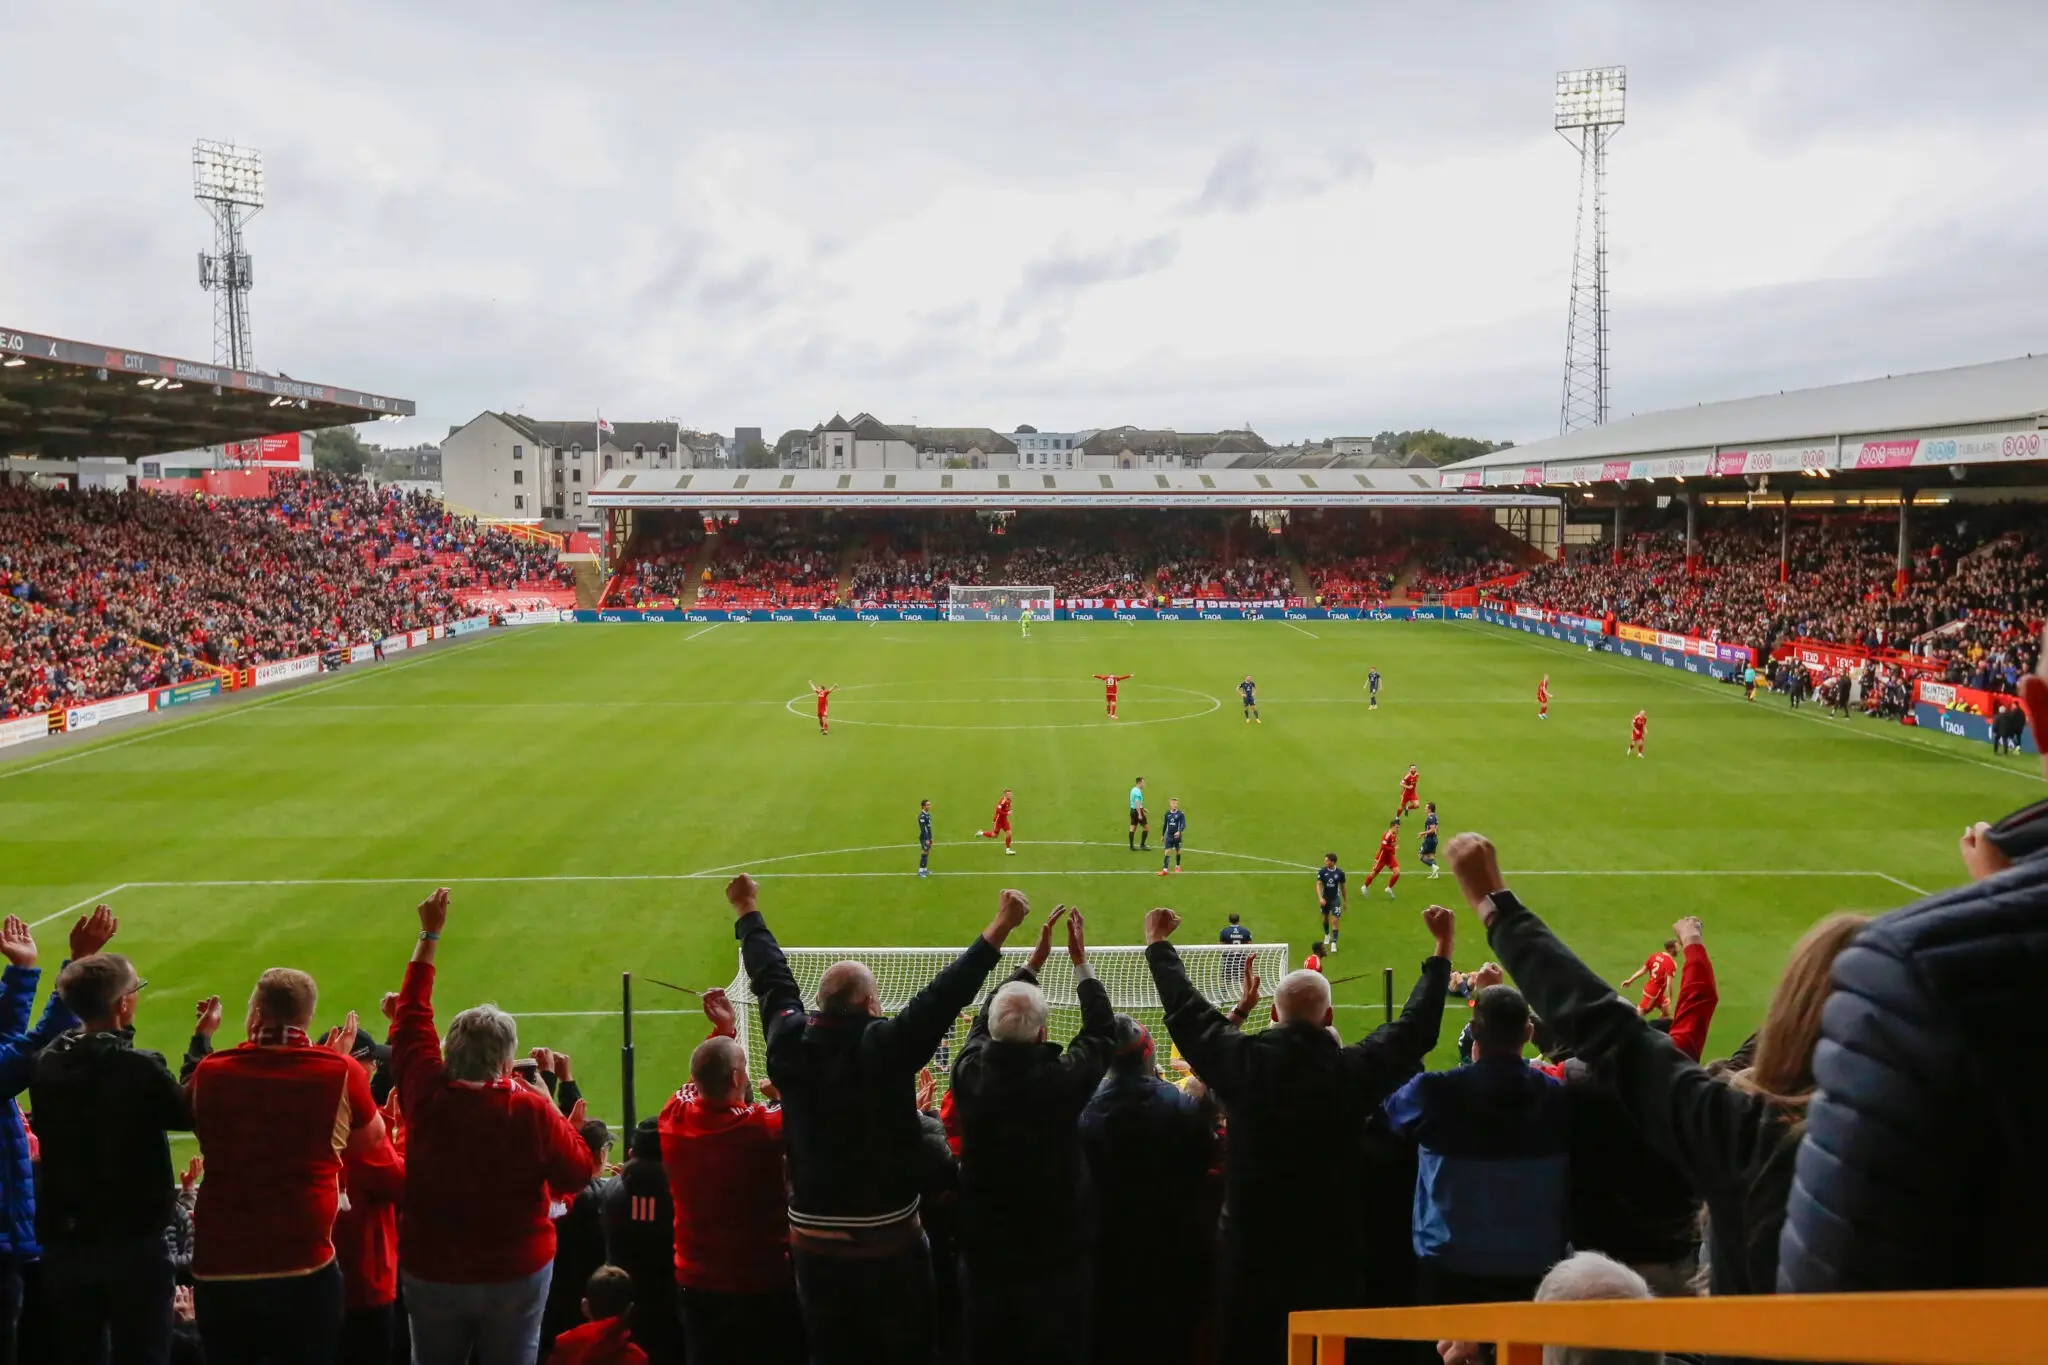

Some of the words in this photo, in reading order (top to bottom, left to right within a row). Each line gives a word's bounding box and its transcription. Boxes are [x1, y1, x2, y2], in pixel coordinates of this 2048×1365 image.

[124, 354, 144, 369] CITY
[176, 362, 220, 382] COMMUNITY
[1925, 440, 1956, 461] RAM
[1959, 441, 1997, 454] TUBULARS
[2002, 434, 2040, 456] RAM
[1802, 651, 1818, 663] TEXO
[1712, 668, 1723, 679] TAQA
[1945, 721, 1964, 736] TAQA
[1652, 962, 1660, 978] 2
